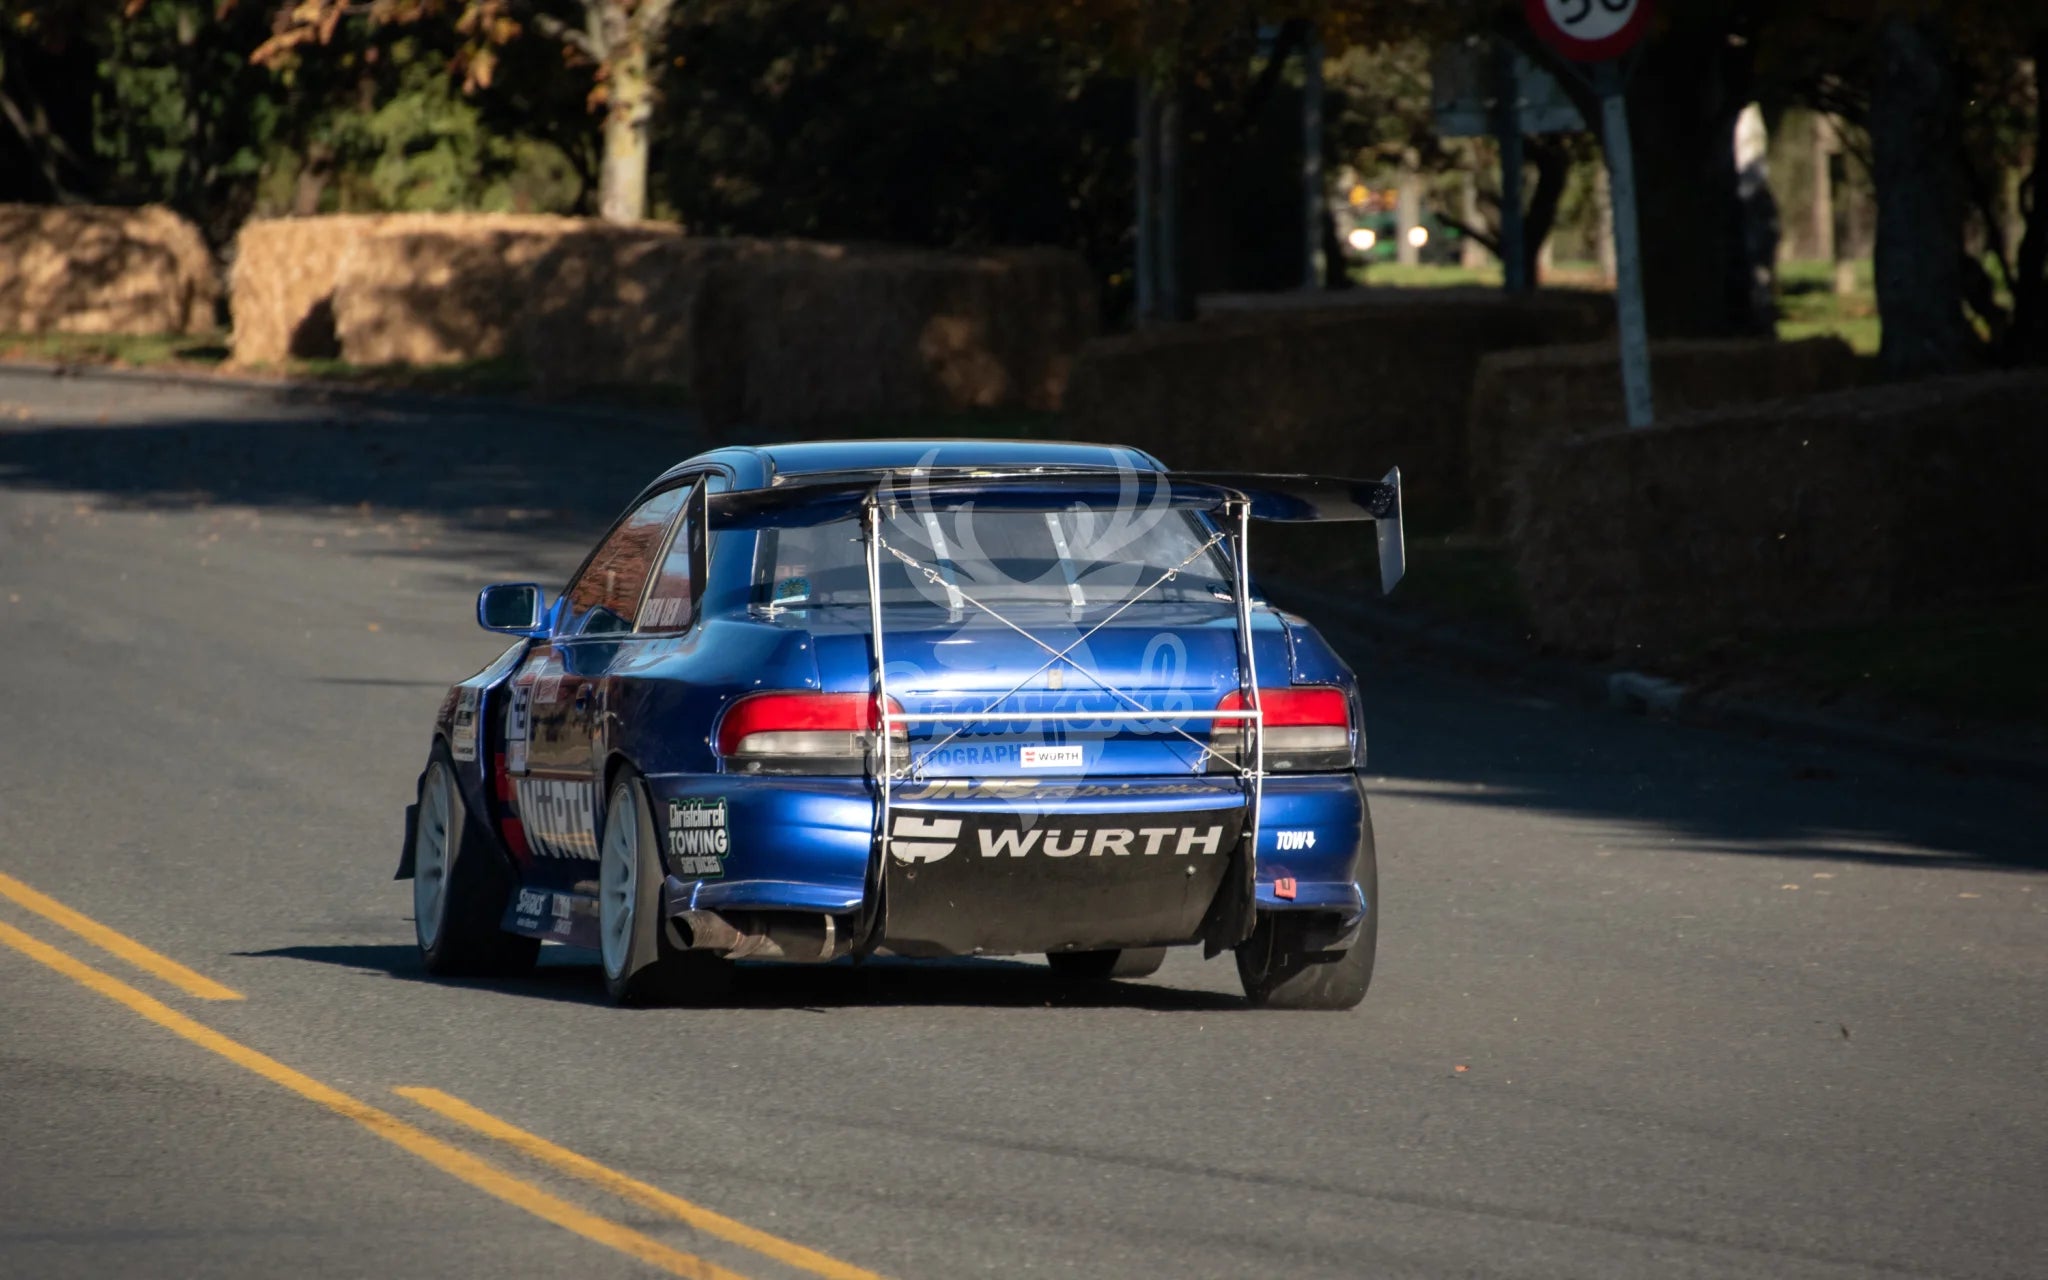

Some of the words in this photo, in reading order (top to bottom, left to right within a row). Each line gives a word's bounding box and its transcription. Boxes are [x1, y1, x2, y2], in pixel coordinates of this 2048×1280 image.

[668, 829, 728, 855] TOWING
[978, 826, 1224, 857] WÜRTH
[1276, 831, 1306, 850] TOW
